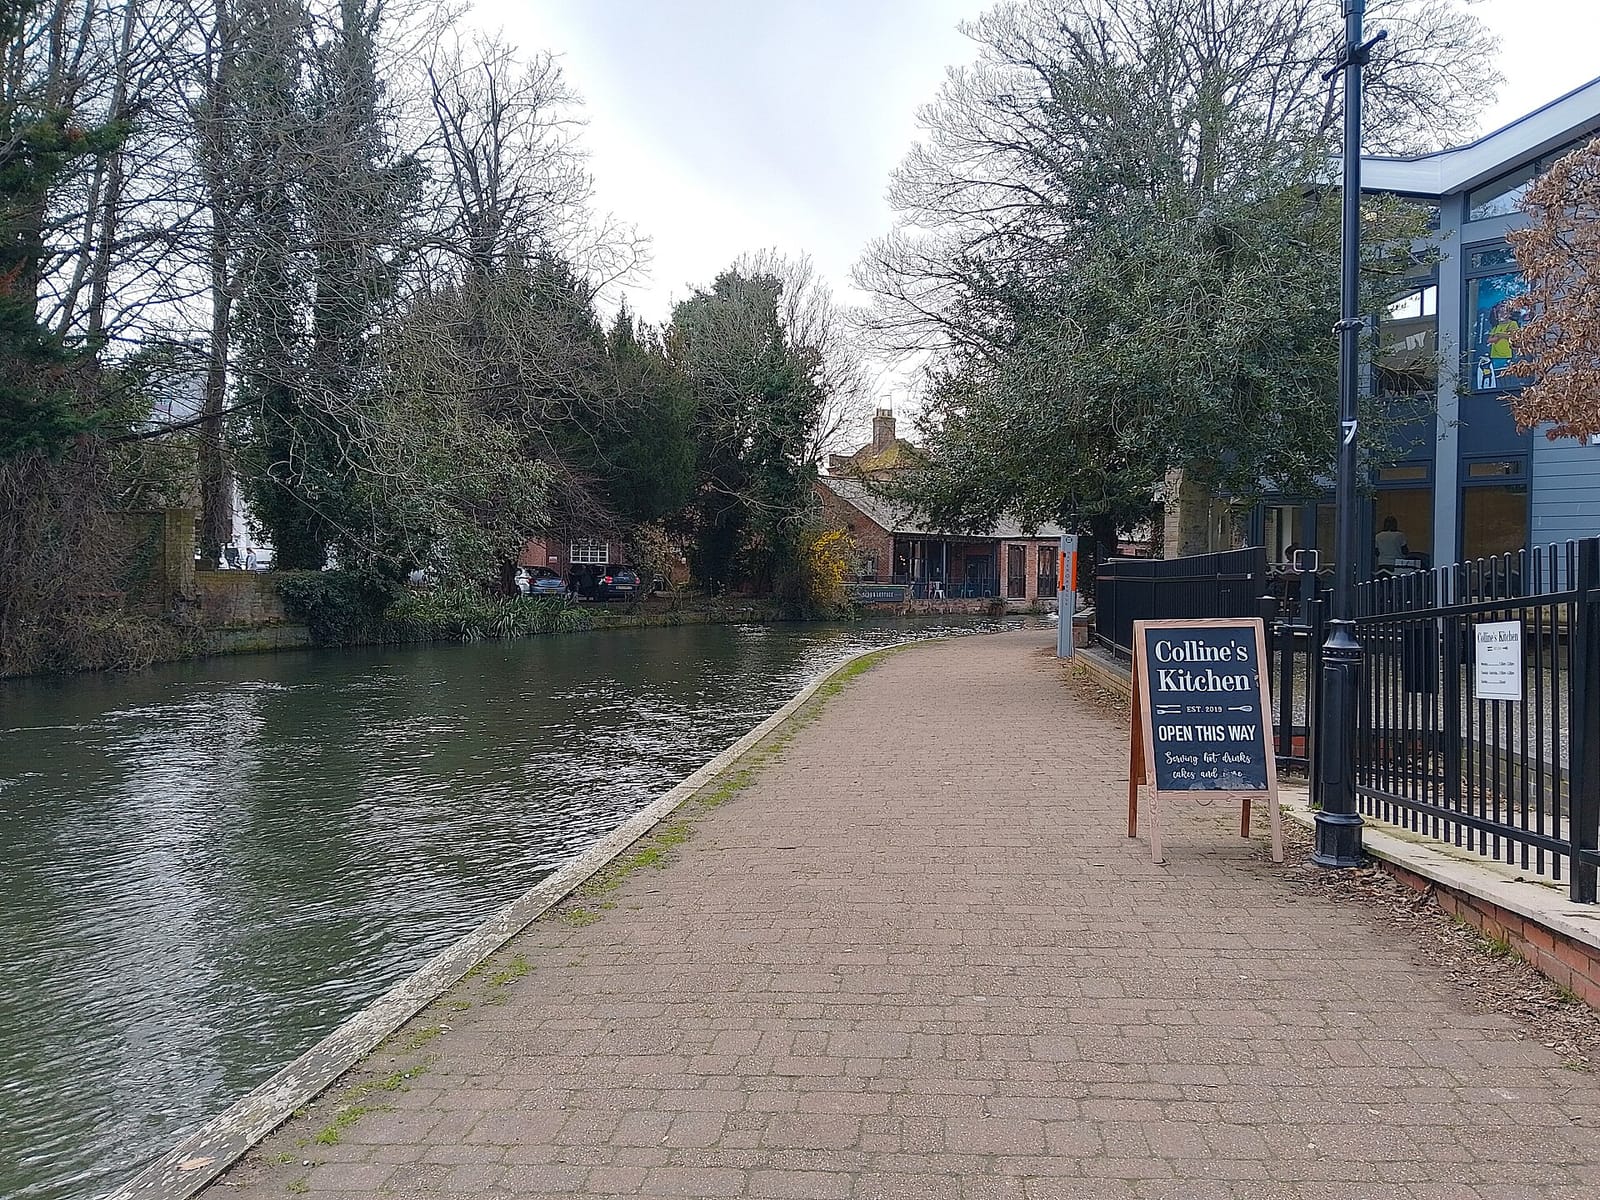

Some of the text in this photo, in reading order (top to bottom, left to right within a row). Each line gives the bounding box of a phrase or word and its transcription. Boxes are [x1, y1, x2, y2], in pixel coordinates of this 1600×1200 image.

[1342, 420, 1357, 445] 7
[1155, 640, 1249, 662] Colline's
[1156, 669, 1251, 692] Kitchen
[1158, 725, 1256, 741] OPEN THIS WAY
[1164, 751, 1251, 766] Serving hot drinks
[1172, 768, 1196, 779] cakes
[1200, 767, 1218, 778] and
